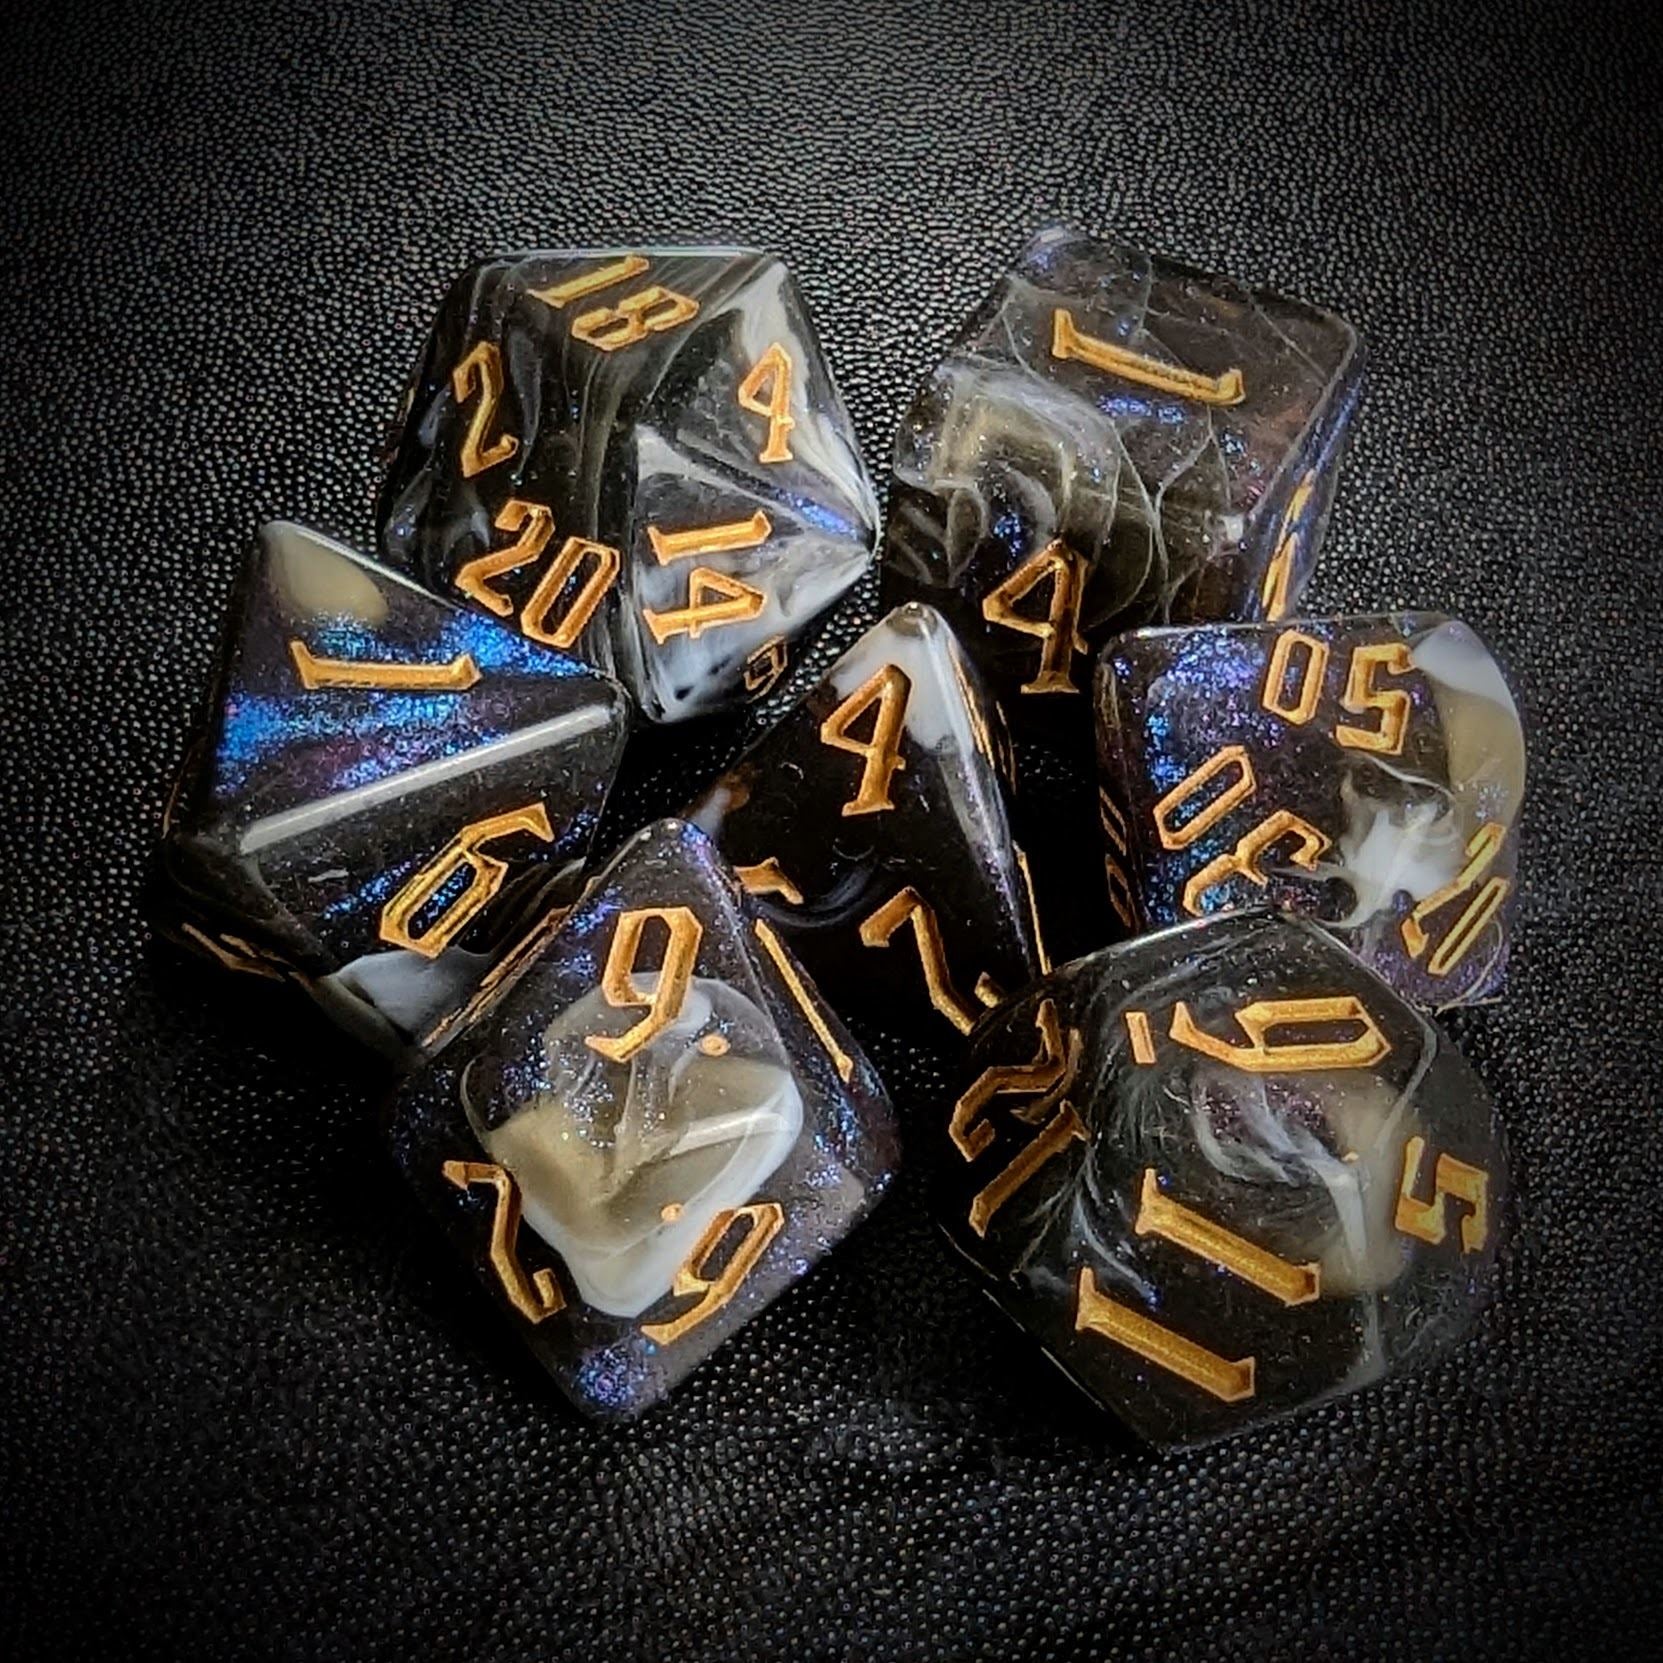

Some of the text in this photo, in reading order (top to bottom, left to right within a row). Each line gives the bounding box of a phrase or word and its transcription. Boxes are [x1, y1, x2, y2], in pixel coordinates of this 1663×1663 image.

[528, 254, 700, 352] 18
[1051, 308, 1246, 407] 1
[452, 341, 518, 478] 2
[738, 342, 795, 464] 4
[455, 500, 621, 650] 20
[642, 509, 773, 645] 14
[982, 538, 1090, 695] 4
[289, 640, 483, 691] 1
[820, 664, 906, 817] 4
[1394, 1135, 1490, 1254] 5
